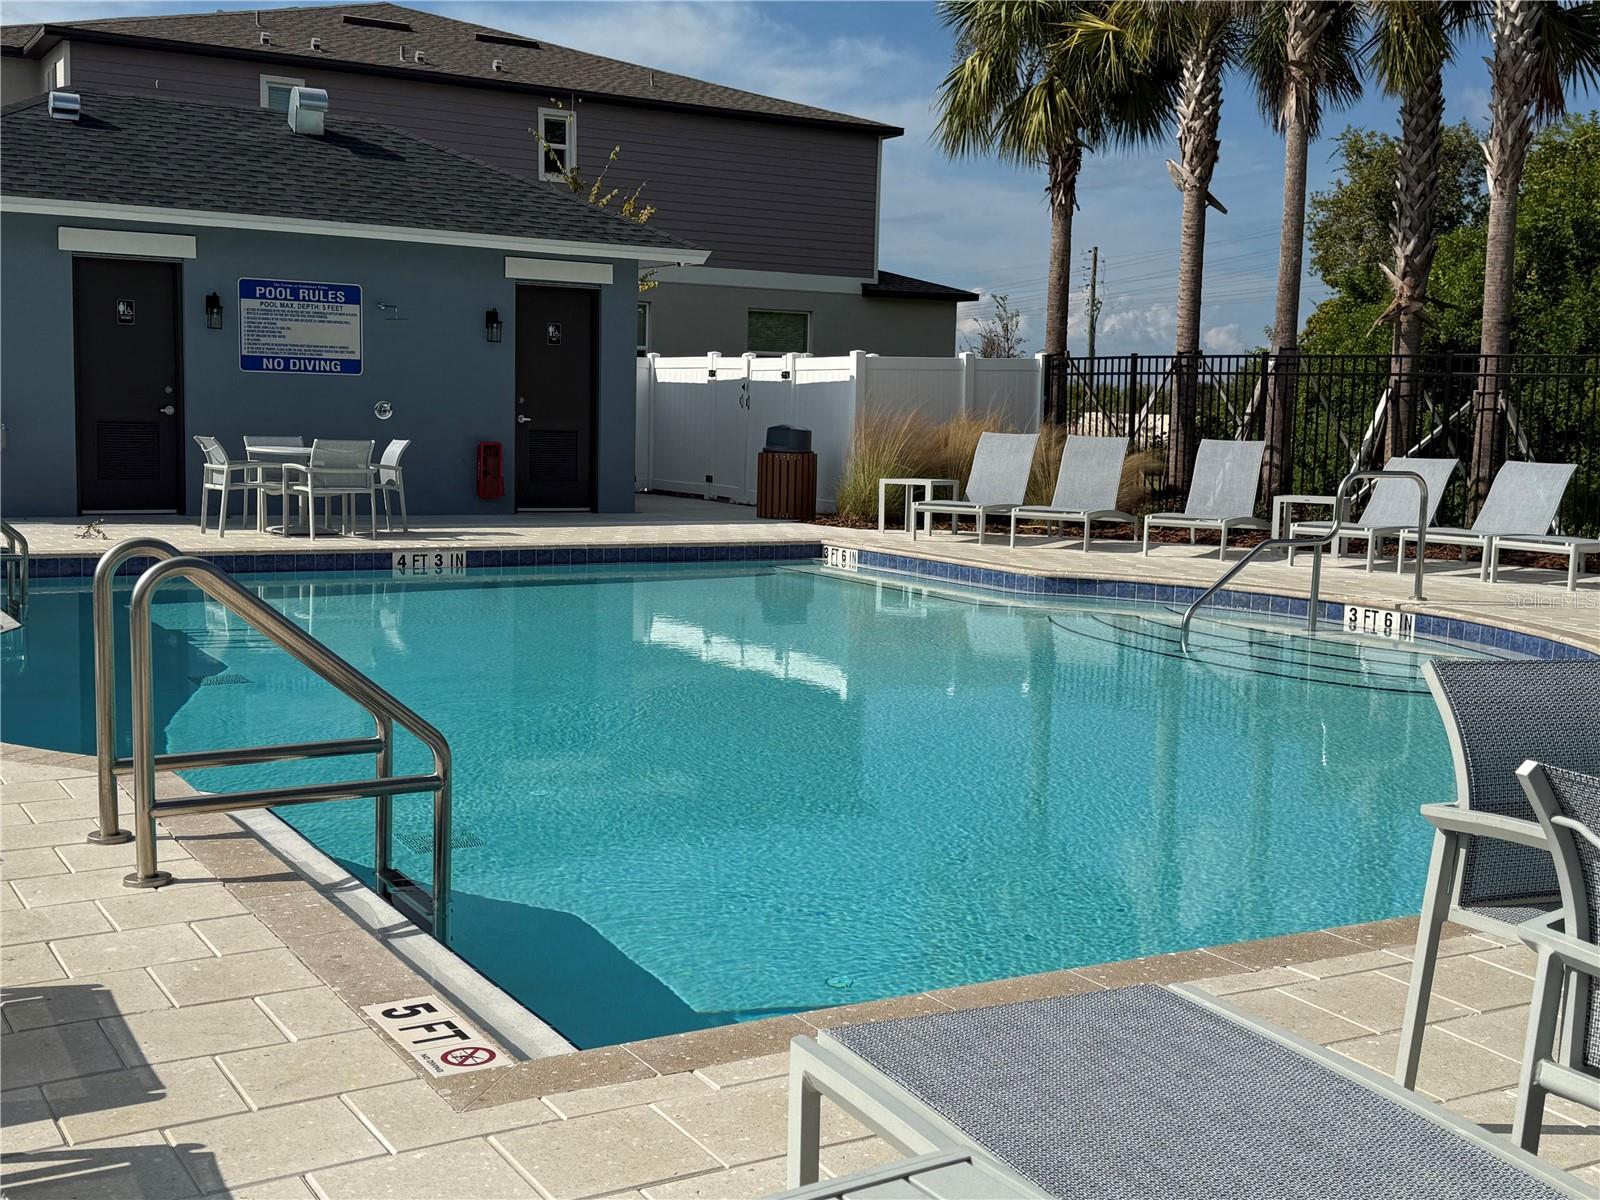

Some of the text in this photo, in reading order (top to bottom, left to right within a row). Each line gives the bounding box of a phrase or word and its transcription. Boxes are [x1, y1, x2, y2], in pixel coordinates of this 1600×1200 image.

[256, 286, 294, 300] POOL
[299, 289, 345, 302] RULES
[328, 304, 343, 312] FEET
[263, 358, 341, 372] NO DIVING
[397, 553, 464, 568] 4 FT 3 IN
[824, 547, 857, 564] 3 FT 6 IN
[1349, 607, 1412, 631] 3 FT 6 IN
[381, 1003, 471, 1044] 5 FT
[427, 1060, 444, 1072] DIVING
